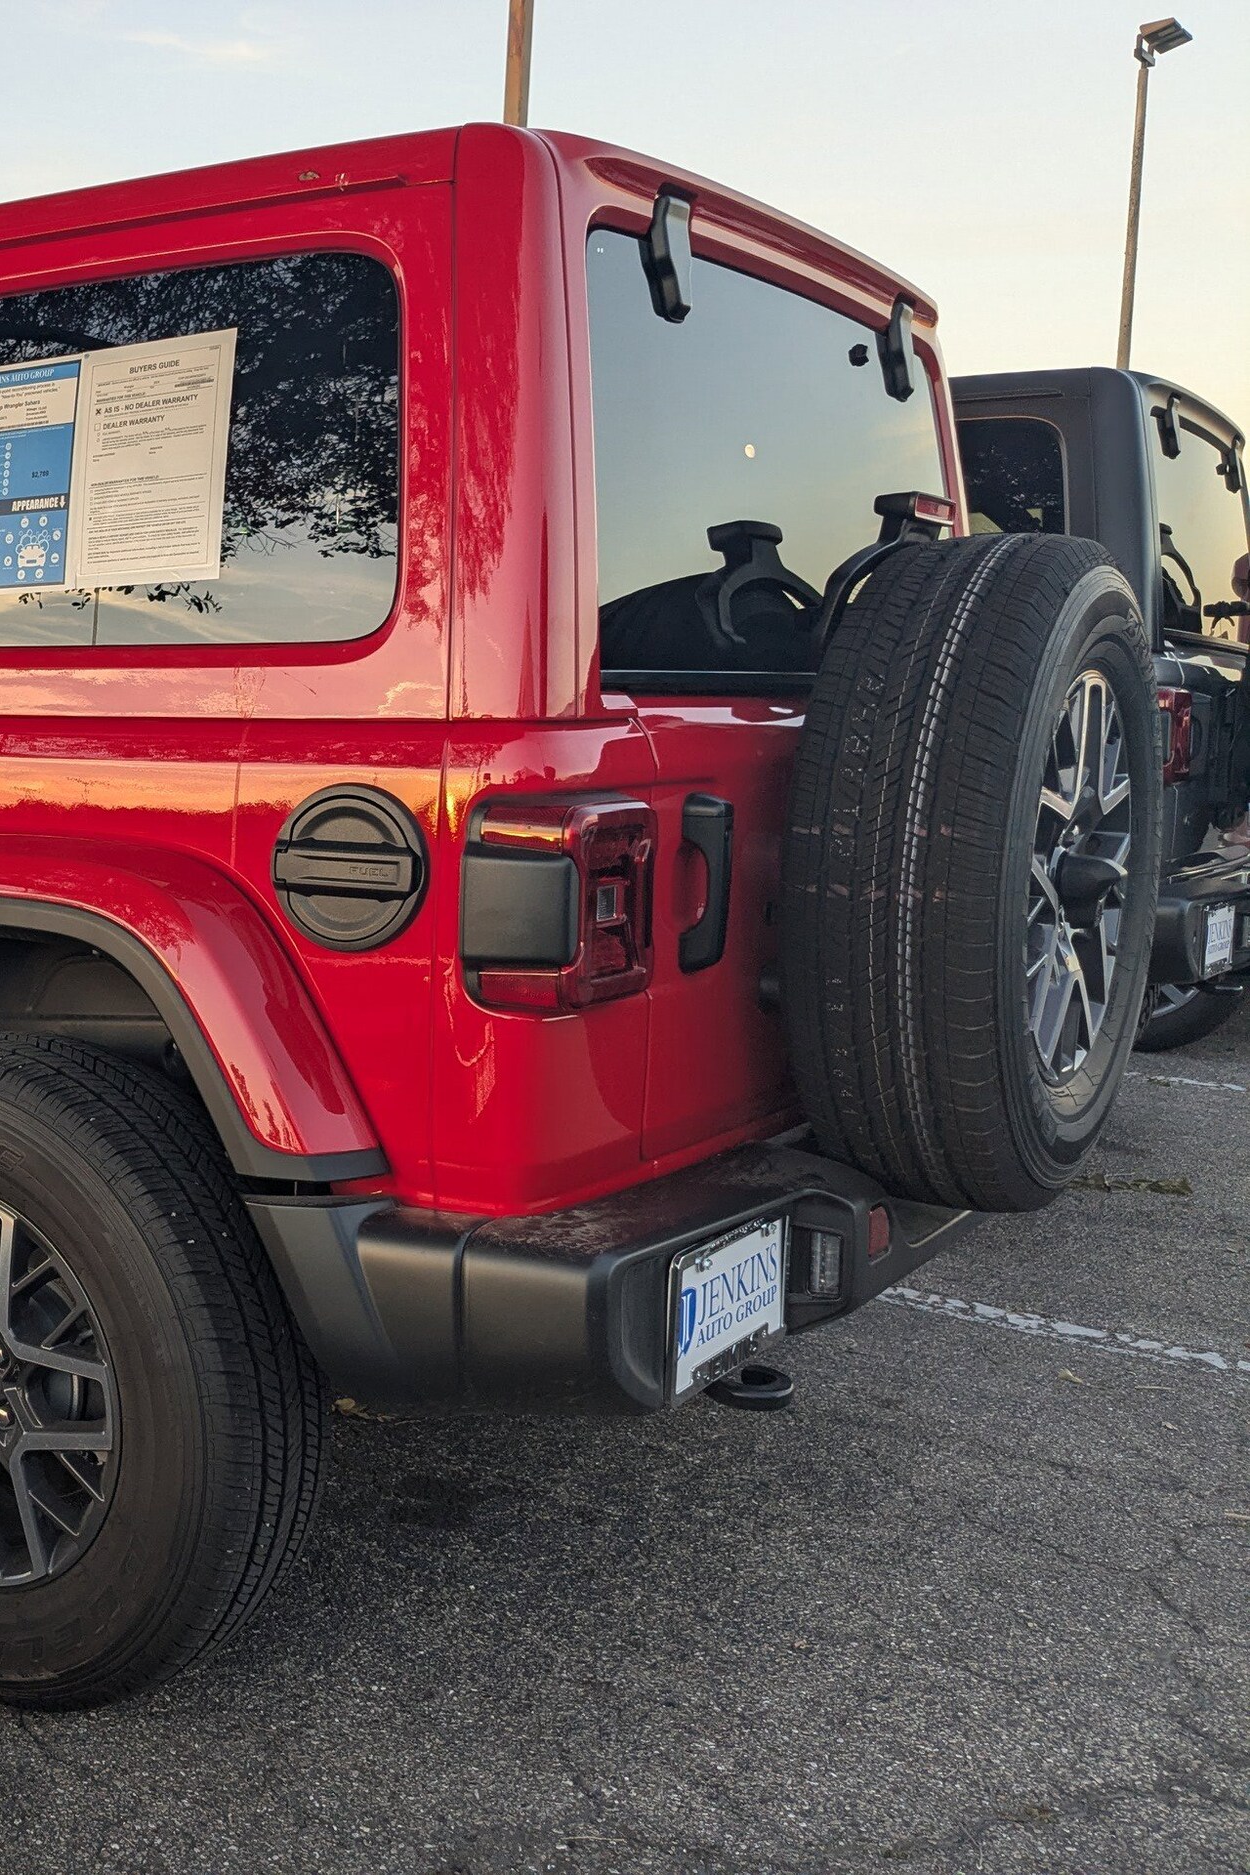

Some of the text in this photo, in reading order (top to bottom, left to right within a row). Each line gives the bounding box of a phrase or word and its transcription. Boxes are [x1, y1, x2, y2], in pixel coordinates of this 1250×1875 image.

[129, 359, 180, 374] BUYERS GUIDE
[11, 372, 29, 383] AUTO
[30, 369, 55, 380] GROUP
[104, 406, 113, 414] AS
[124, 403, 134, 411] NO
[135, 399, 161, 409] DEALER
[162, 394, 199, 405] WARRANTY
[103, 415, 165, 430] DEALER WARRANTY
[12, 498, 59, 511] APPEARANCE
[349, 866, 389, 877] FUEL
[698, 1243, 777, 1325] JENKINS
[696, 1284, 778, 1348] AUTO GROUP
